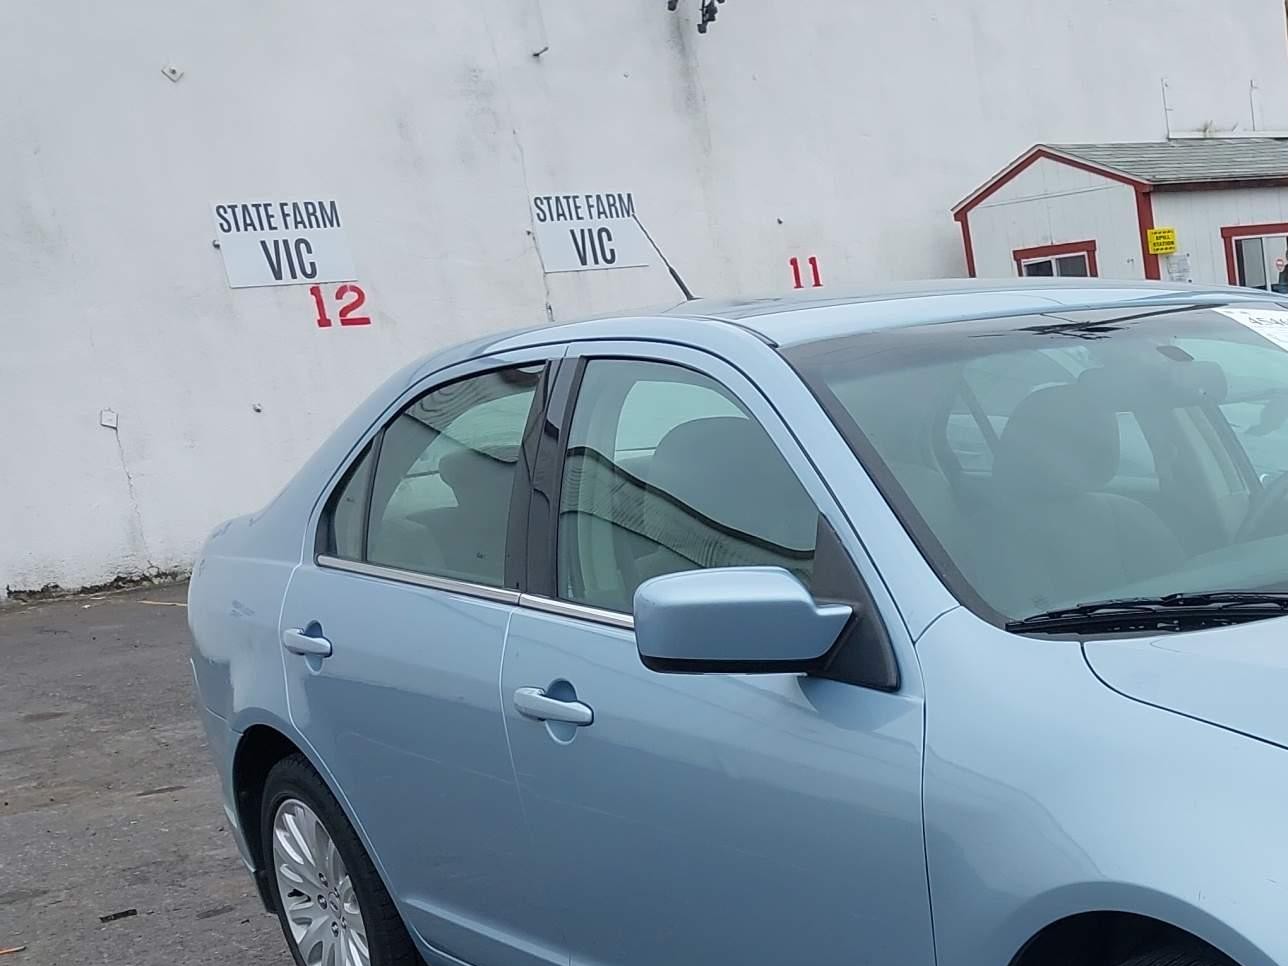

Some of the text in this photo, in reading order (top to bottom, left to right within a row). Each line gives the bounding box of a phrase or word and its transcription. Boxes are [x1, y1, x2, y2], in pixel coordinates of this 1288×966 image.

[215, 200, 342, 233] STATE FARM
[534, 193, 636, 222] STATE FARM
[260, 238, 318, 281] VIC
[570, 227, 617, 266] VIC
[790, 256, 824, 289] 11
[309, 285, 372, 328] 12
